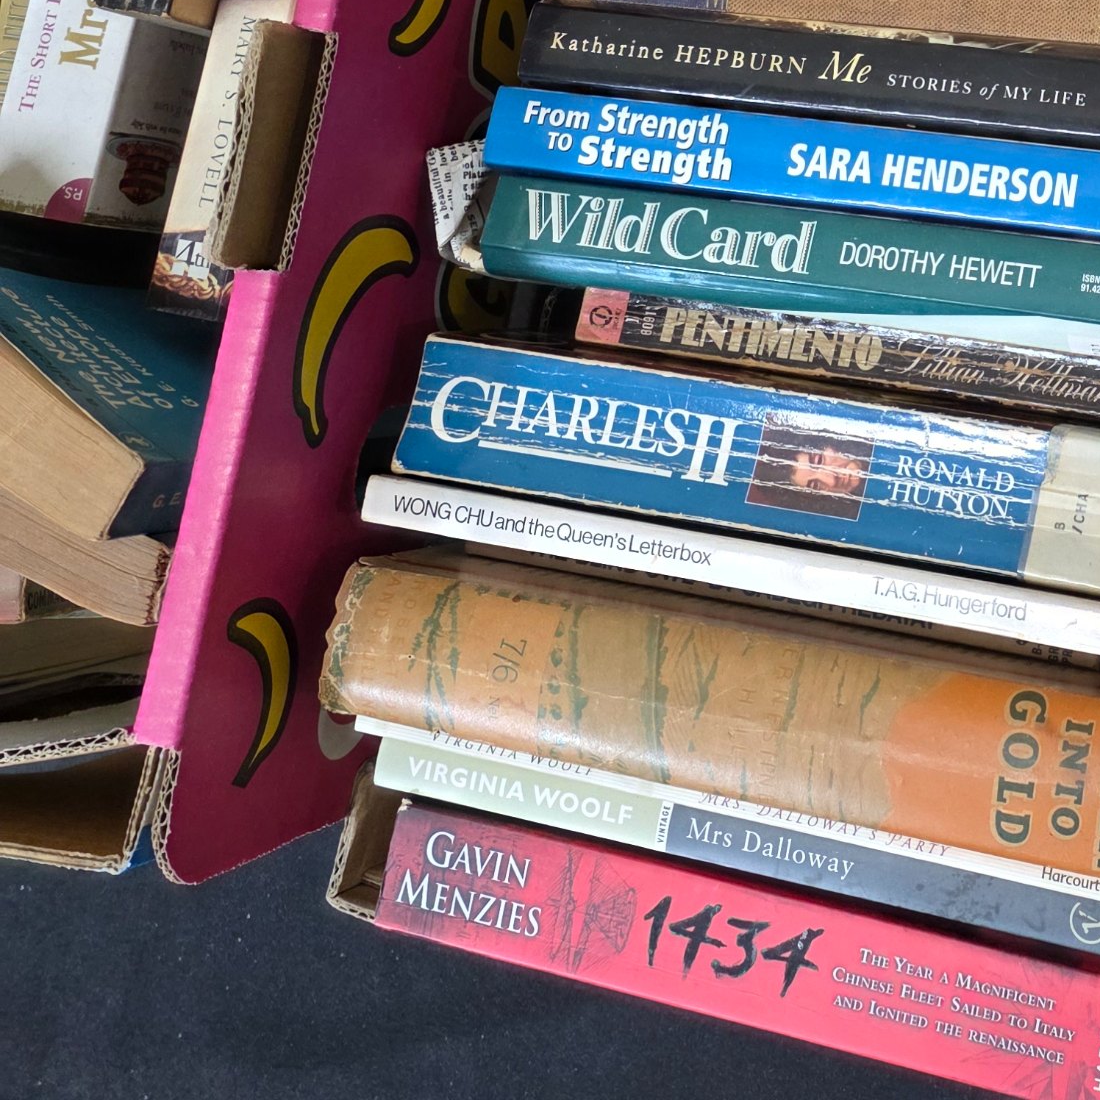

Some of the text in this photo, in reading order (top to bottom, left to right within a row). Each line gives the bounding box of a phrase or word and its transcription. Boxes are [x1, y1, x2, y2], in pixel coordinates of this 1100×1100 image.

[18, 74, 42, 112] THE
[31, 10, 59, 69] SHORT
[550, 32, 1087, 107] Katharine HEPBURN Me STORIES of MY LIFE
[199, 16, 257, 209] MARY S. LOVELL
[523, 100, 729, 146] From Strength
[547, 132, 733, 184] TO Strength
[787, 143, 1078, 208] SARA HENDERSON
[526, 188, 661, 255] Wild
[659, 206, 818, 275] Card
[839, 241, 1042, 289] DOROTHY HEWETT
[659, 307, 883, 371] PENTIMENTO
[430, 376, 741, 486] CHARLES II
[890, 482, 1010, 520] HUTTON
[897, 455, 1015, 493] RONALD
[408, 757, 633, 825] VIRGINIA WOOLF
[990, 690, 1047, 847] GOLD
[1049, 718, 1094, 837] INTO
[656, 805, 671, 843] VINTAGE
[686, 818, 855, 881] Mrs Dalloway
[426, 831, 531, 890] GAVIN
[1041, 866, 1100, 893] Harcourt
[396, 868, 542, 938] MENZIES
[643, 895, 825, 998] 1434
